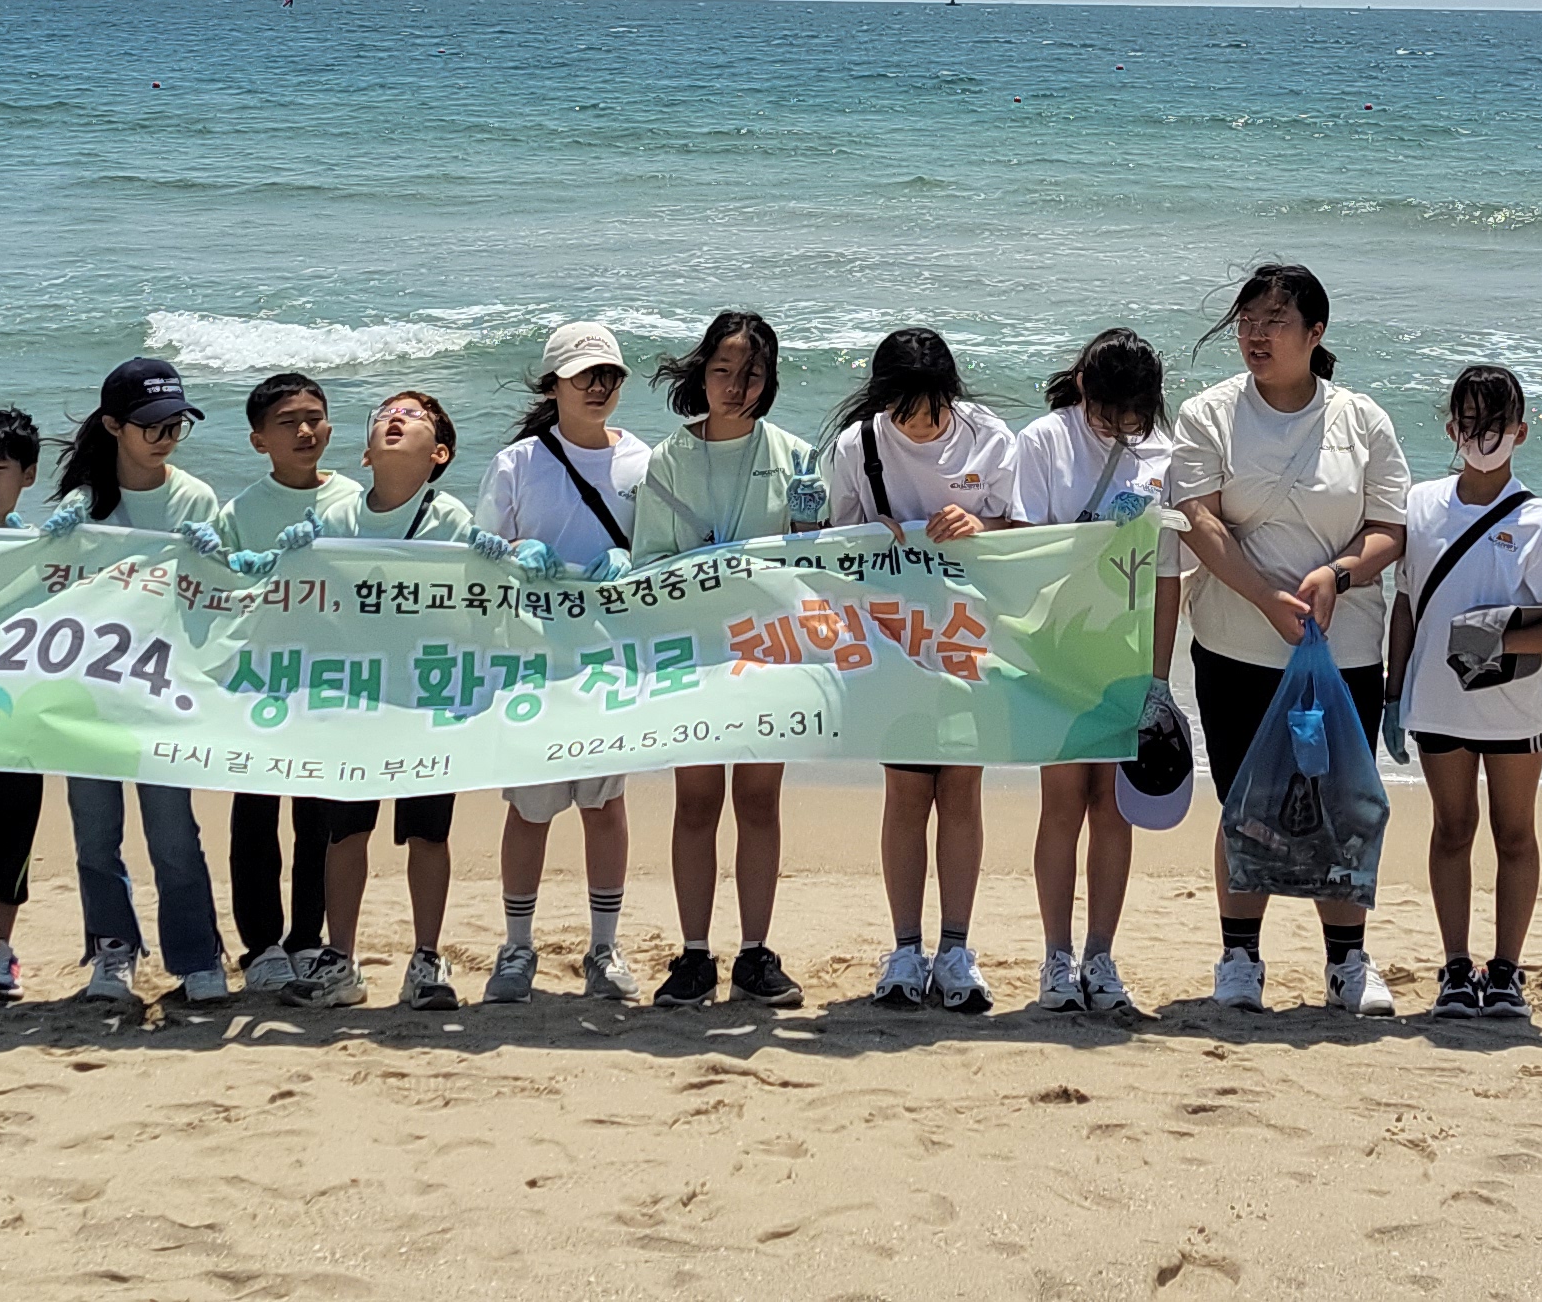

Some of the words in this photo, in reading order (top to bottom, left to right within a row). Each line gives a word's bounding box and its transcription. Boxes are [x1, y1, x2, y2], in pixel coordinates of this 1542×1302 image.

[354, 579, 586, 622] 합천교육지원청
[836, 545, 967, 582] 함께하는
[227, 648, 382, 728] 생태
[413, 643, 548, 727] 환경
[577, 635, 701, 712] 진로
[727, 599, 988, 682] 체험학습
[757, 709, 839, 739] 5.31.
[152, 741, 212, 770] 다시
[225, 750, 254, 775] 갈
[265, 756, 326, 780] 지도
[338, 761, 366, 781] in
[378, 754, 451, 782] 부산!
